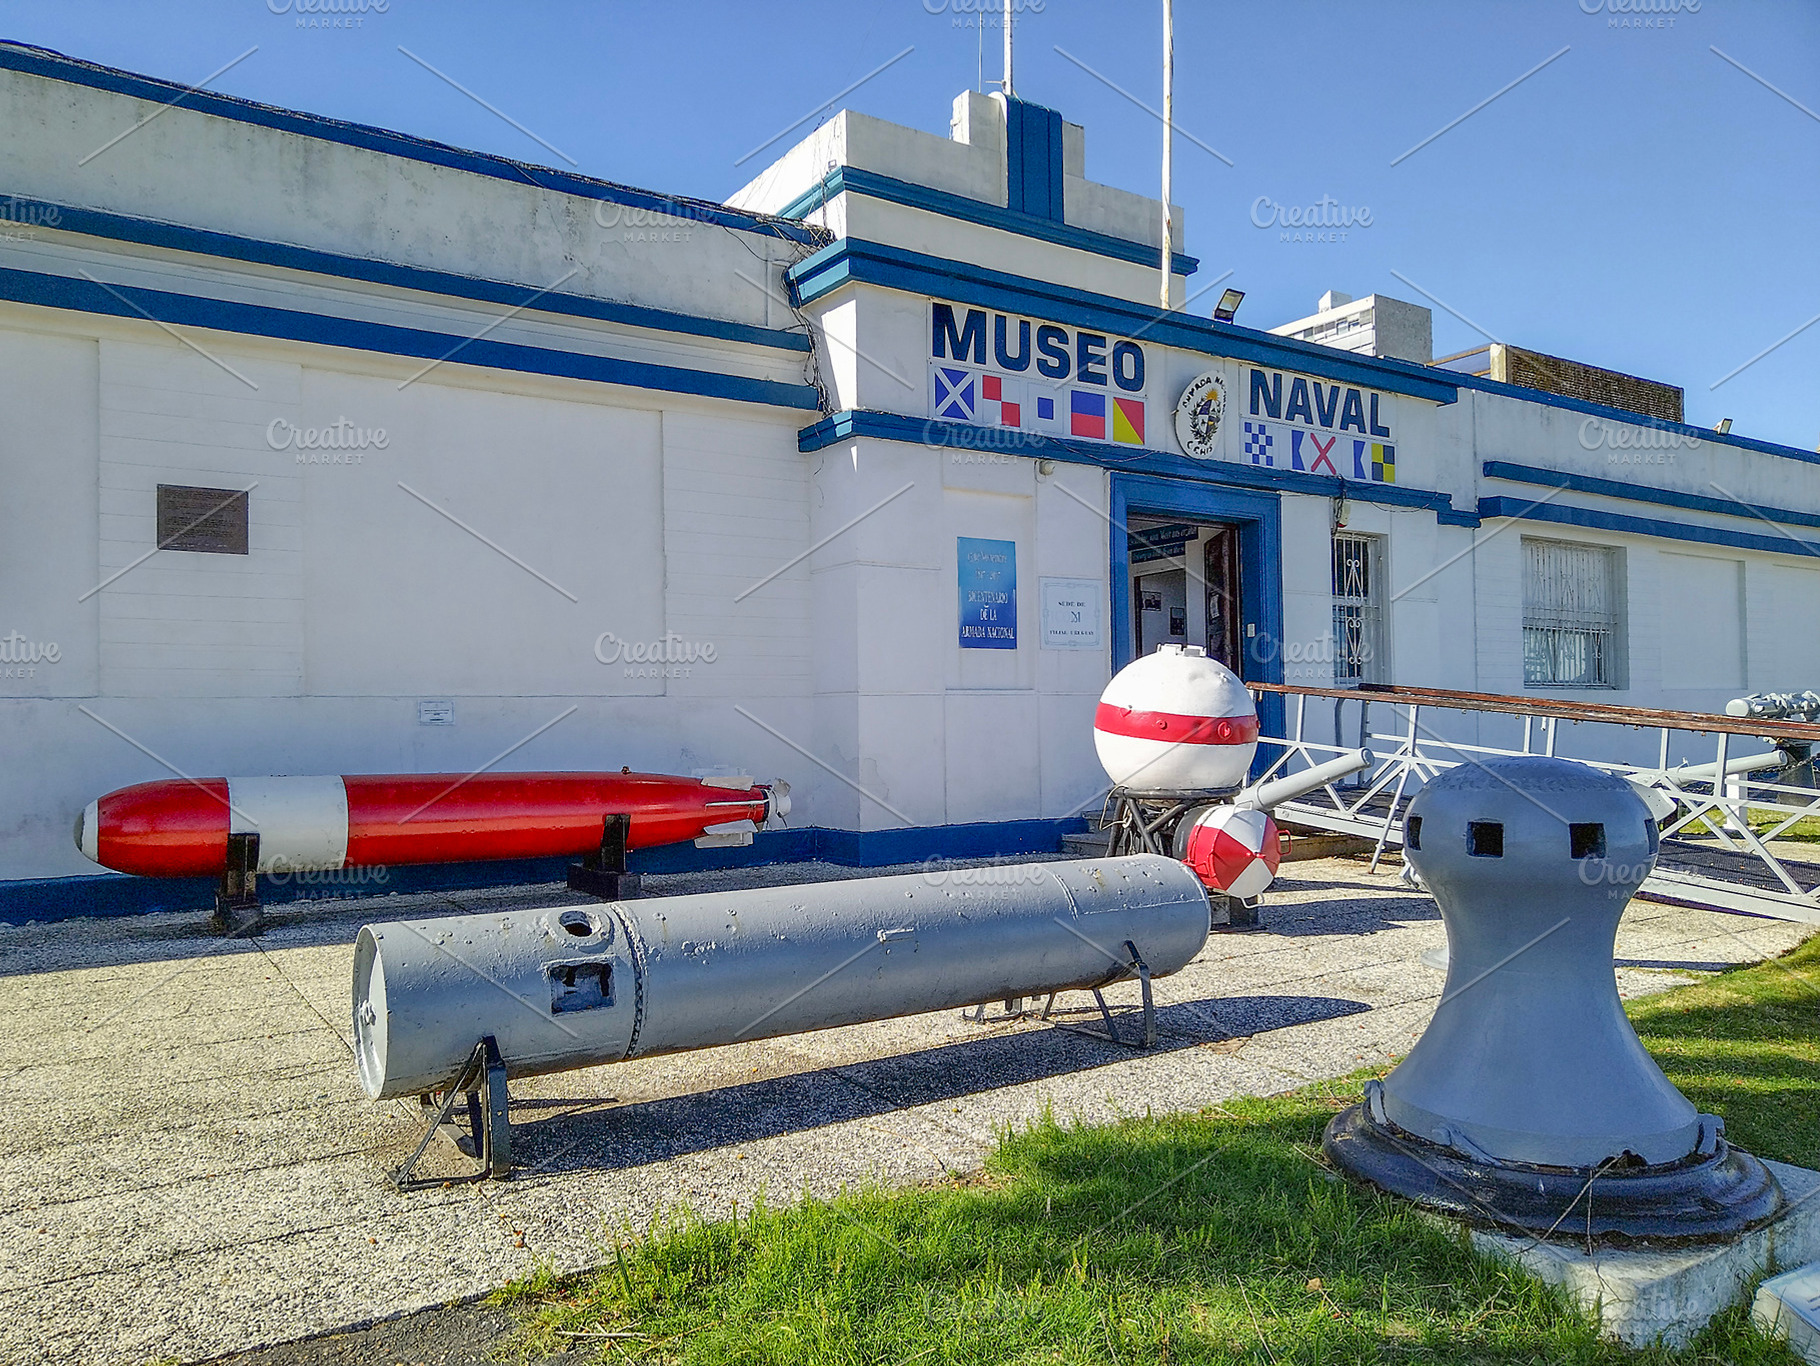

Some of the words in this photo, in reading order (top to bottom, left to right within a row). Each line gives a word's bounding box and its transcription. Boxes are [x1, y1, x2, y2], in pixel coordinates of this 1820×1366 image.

[932, 302, 1145, 392] MUSEO
[1250, 369, 1390, 438] NAVAL
[980, 608, 988, 620] DE
[990, 608, 997, 620] LA
[961, 625, 985, 638] ARMADA
